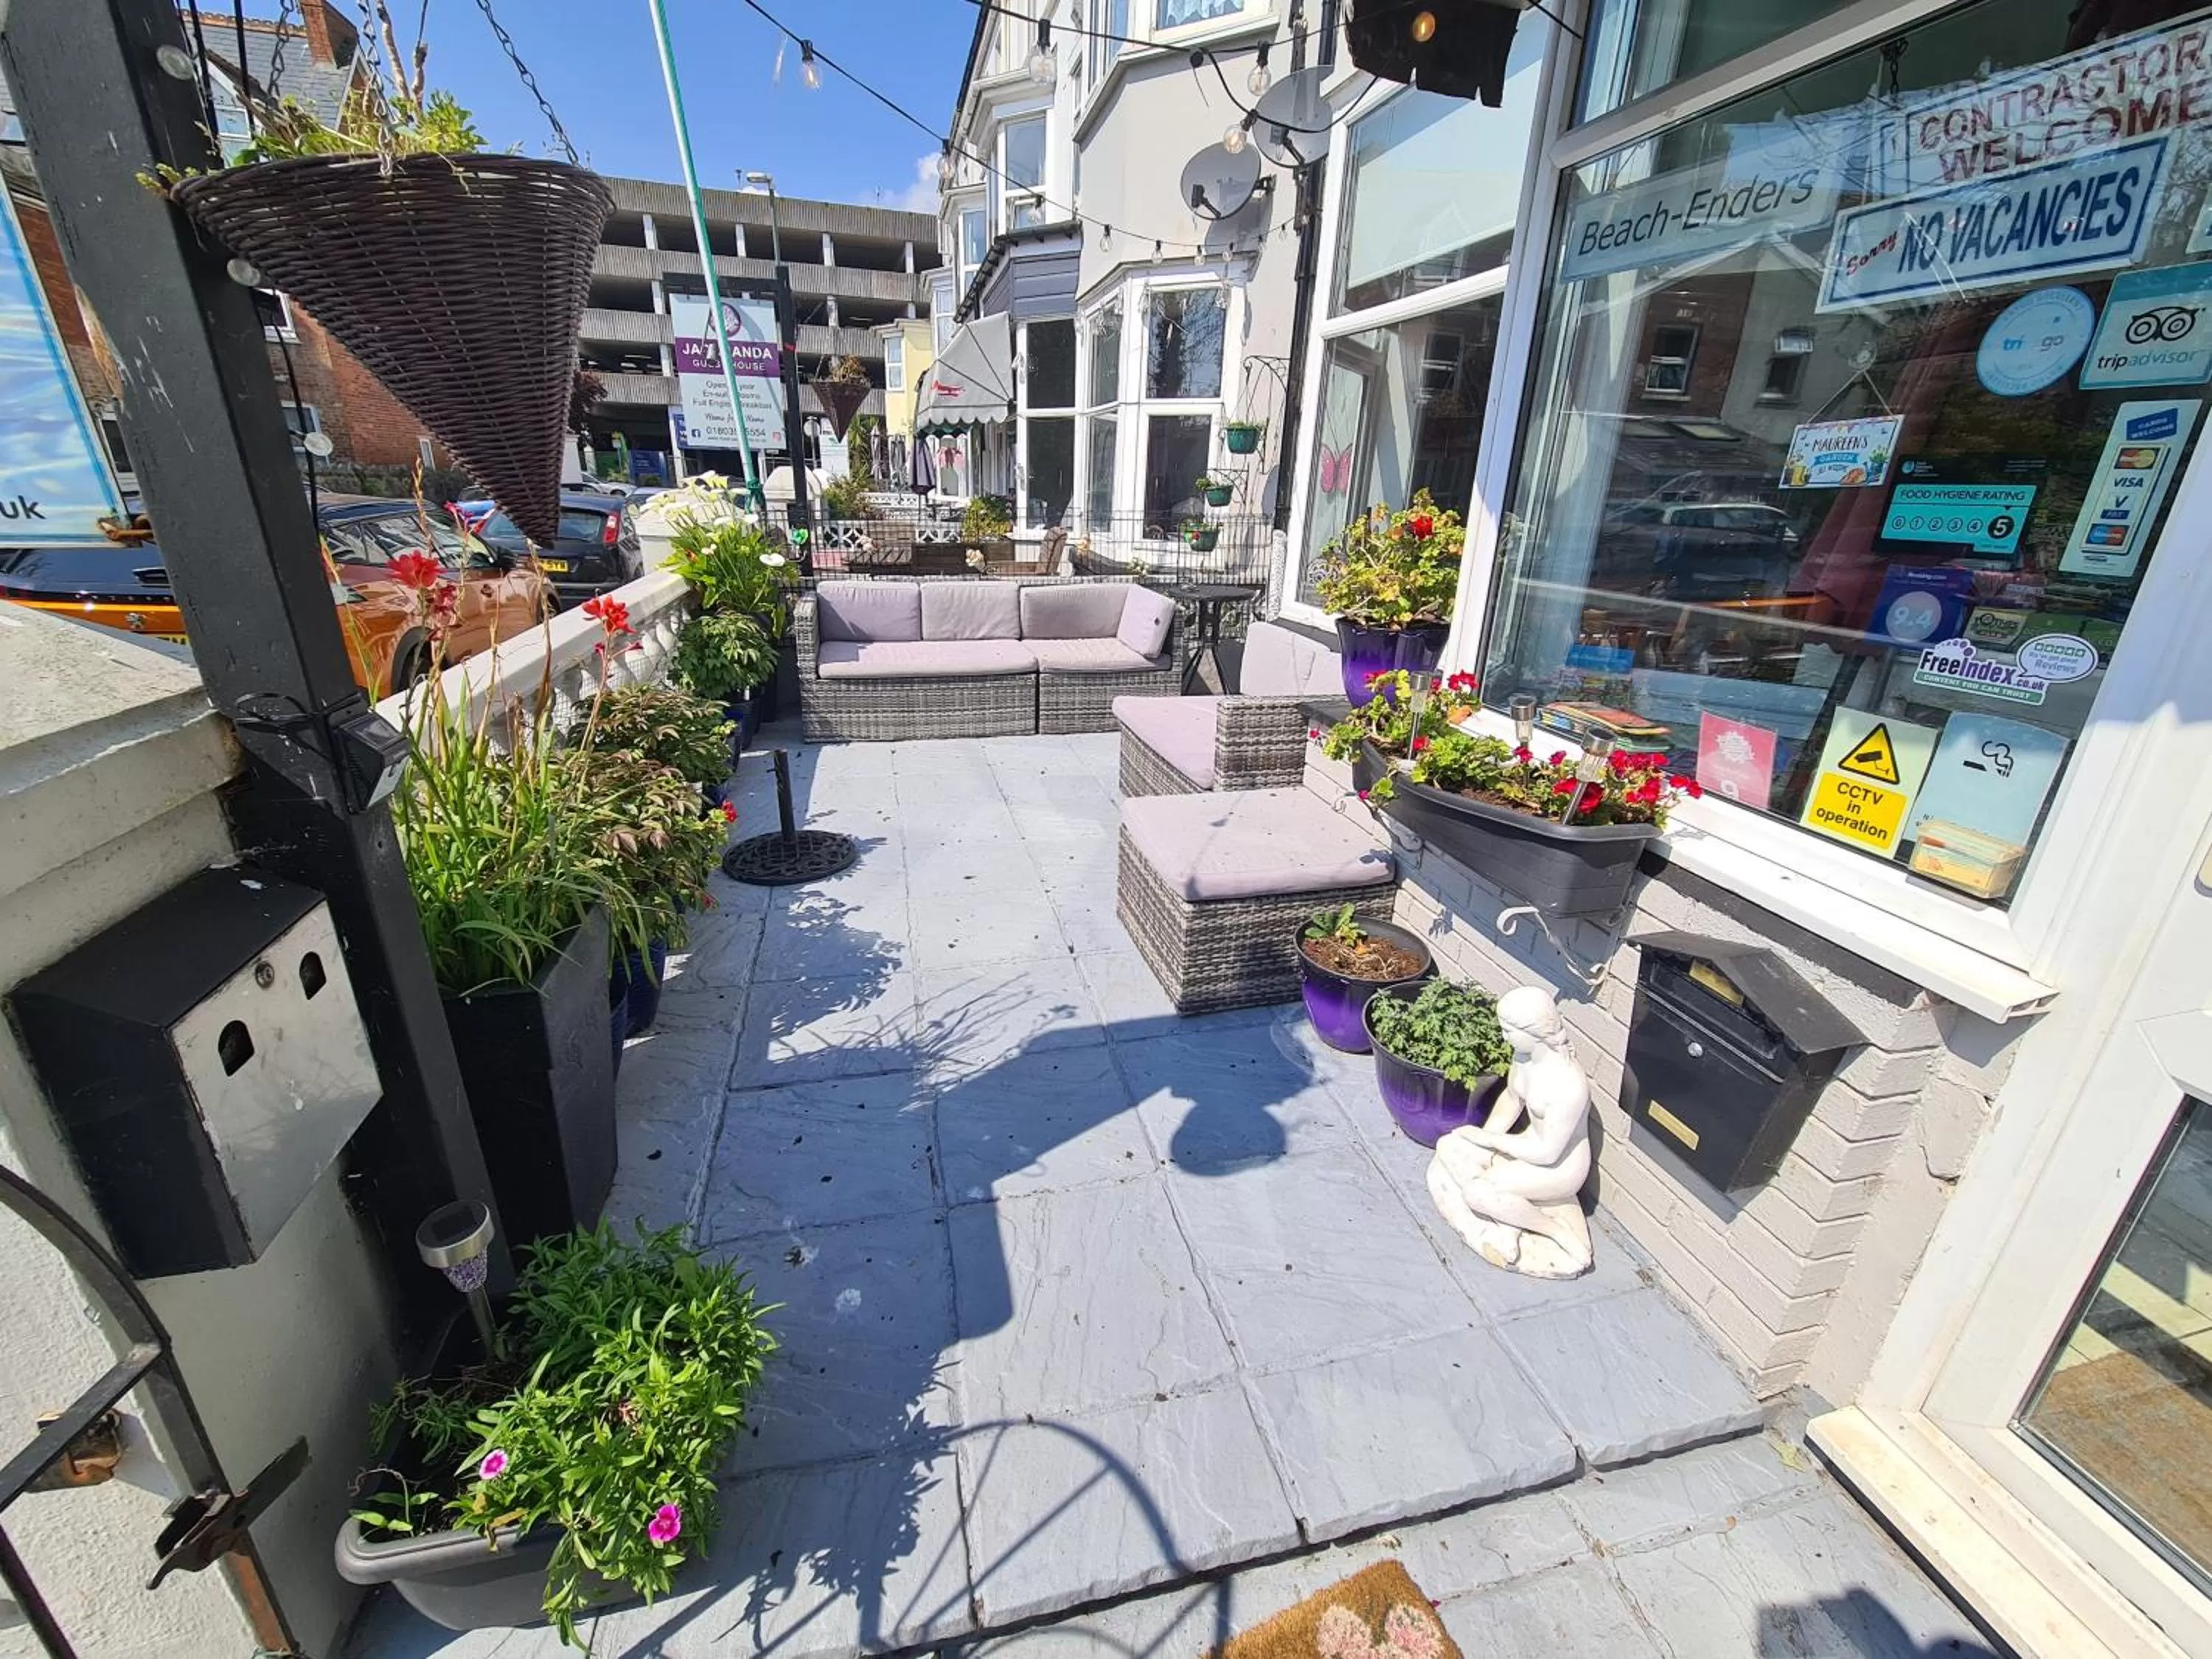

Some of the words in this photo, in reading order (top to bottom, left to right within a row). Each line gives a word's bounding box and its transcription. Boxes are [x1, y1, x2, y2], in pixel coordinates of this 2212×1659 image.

[1920, 32, 2212, 147] CONTRACTOR
[1940, 77, 2212, 184] WELCOME
[1579, 169, 1819, 255] Beach-Enders
[1846, 229, 1898, 276] Sorry
[1898, 212, 1944, 273] NO
[1947, 167, 2138, 264] VACANCIES
[682, 342, 772, 359] JAANDA
[2097, 349, 2197, 372] tripadvisor
[1812, 435, 1869, 452] MAUREEN'S
[2113, 478, 2143, 487] VISA
[1901, 489, 1932, 499] FOOD
[1933, 490, 1982, 500] HYGIENE
[1983, 491, 2025, 501] RATING
[1993, 518, 2008, 537] 5
[1894, 606, 1933, 629] 9.4
[1837, 782, 1884, 805] CCTV
[1846, 800, 1861, 815] in
[1816, 807, 1888, 840] operation
